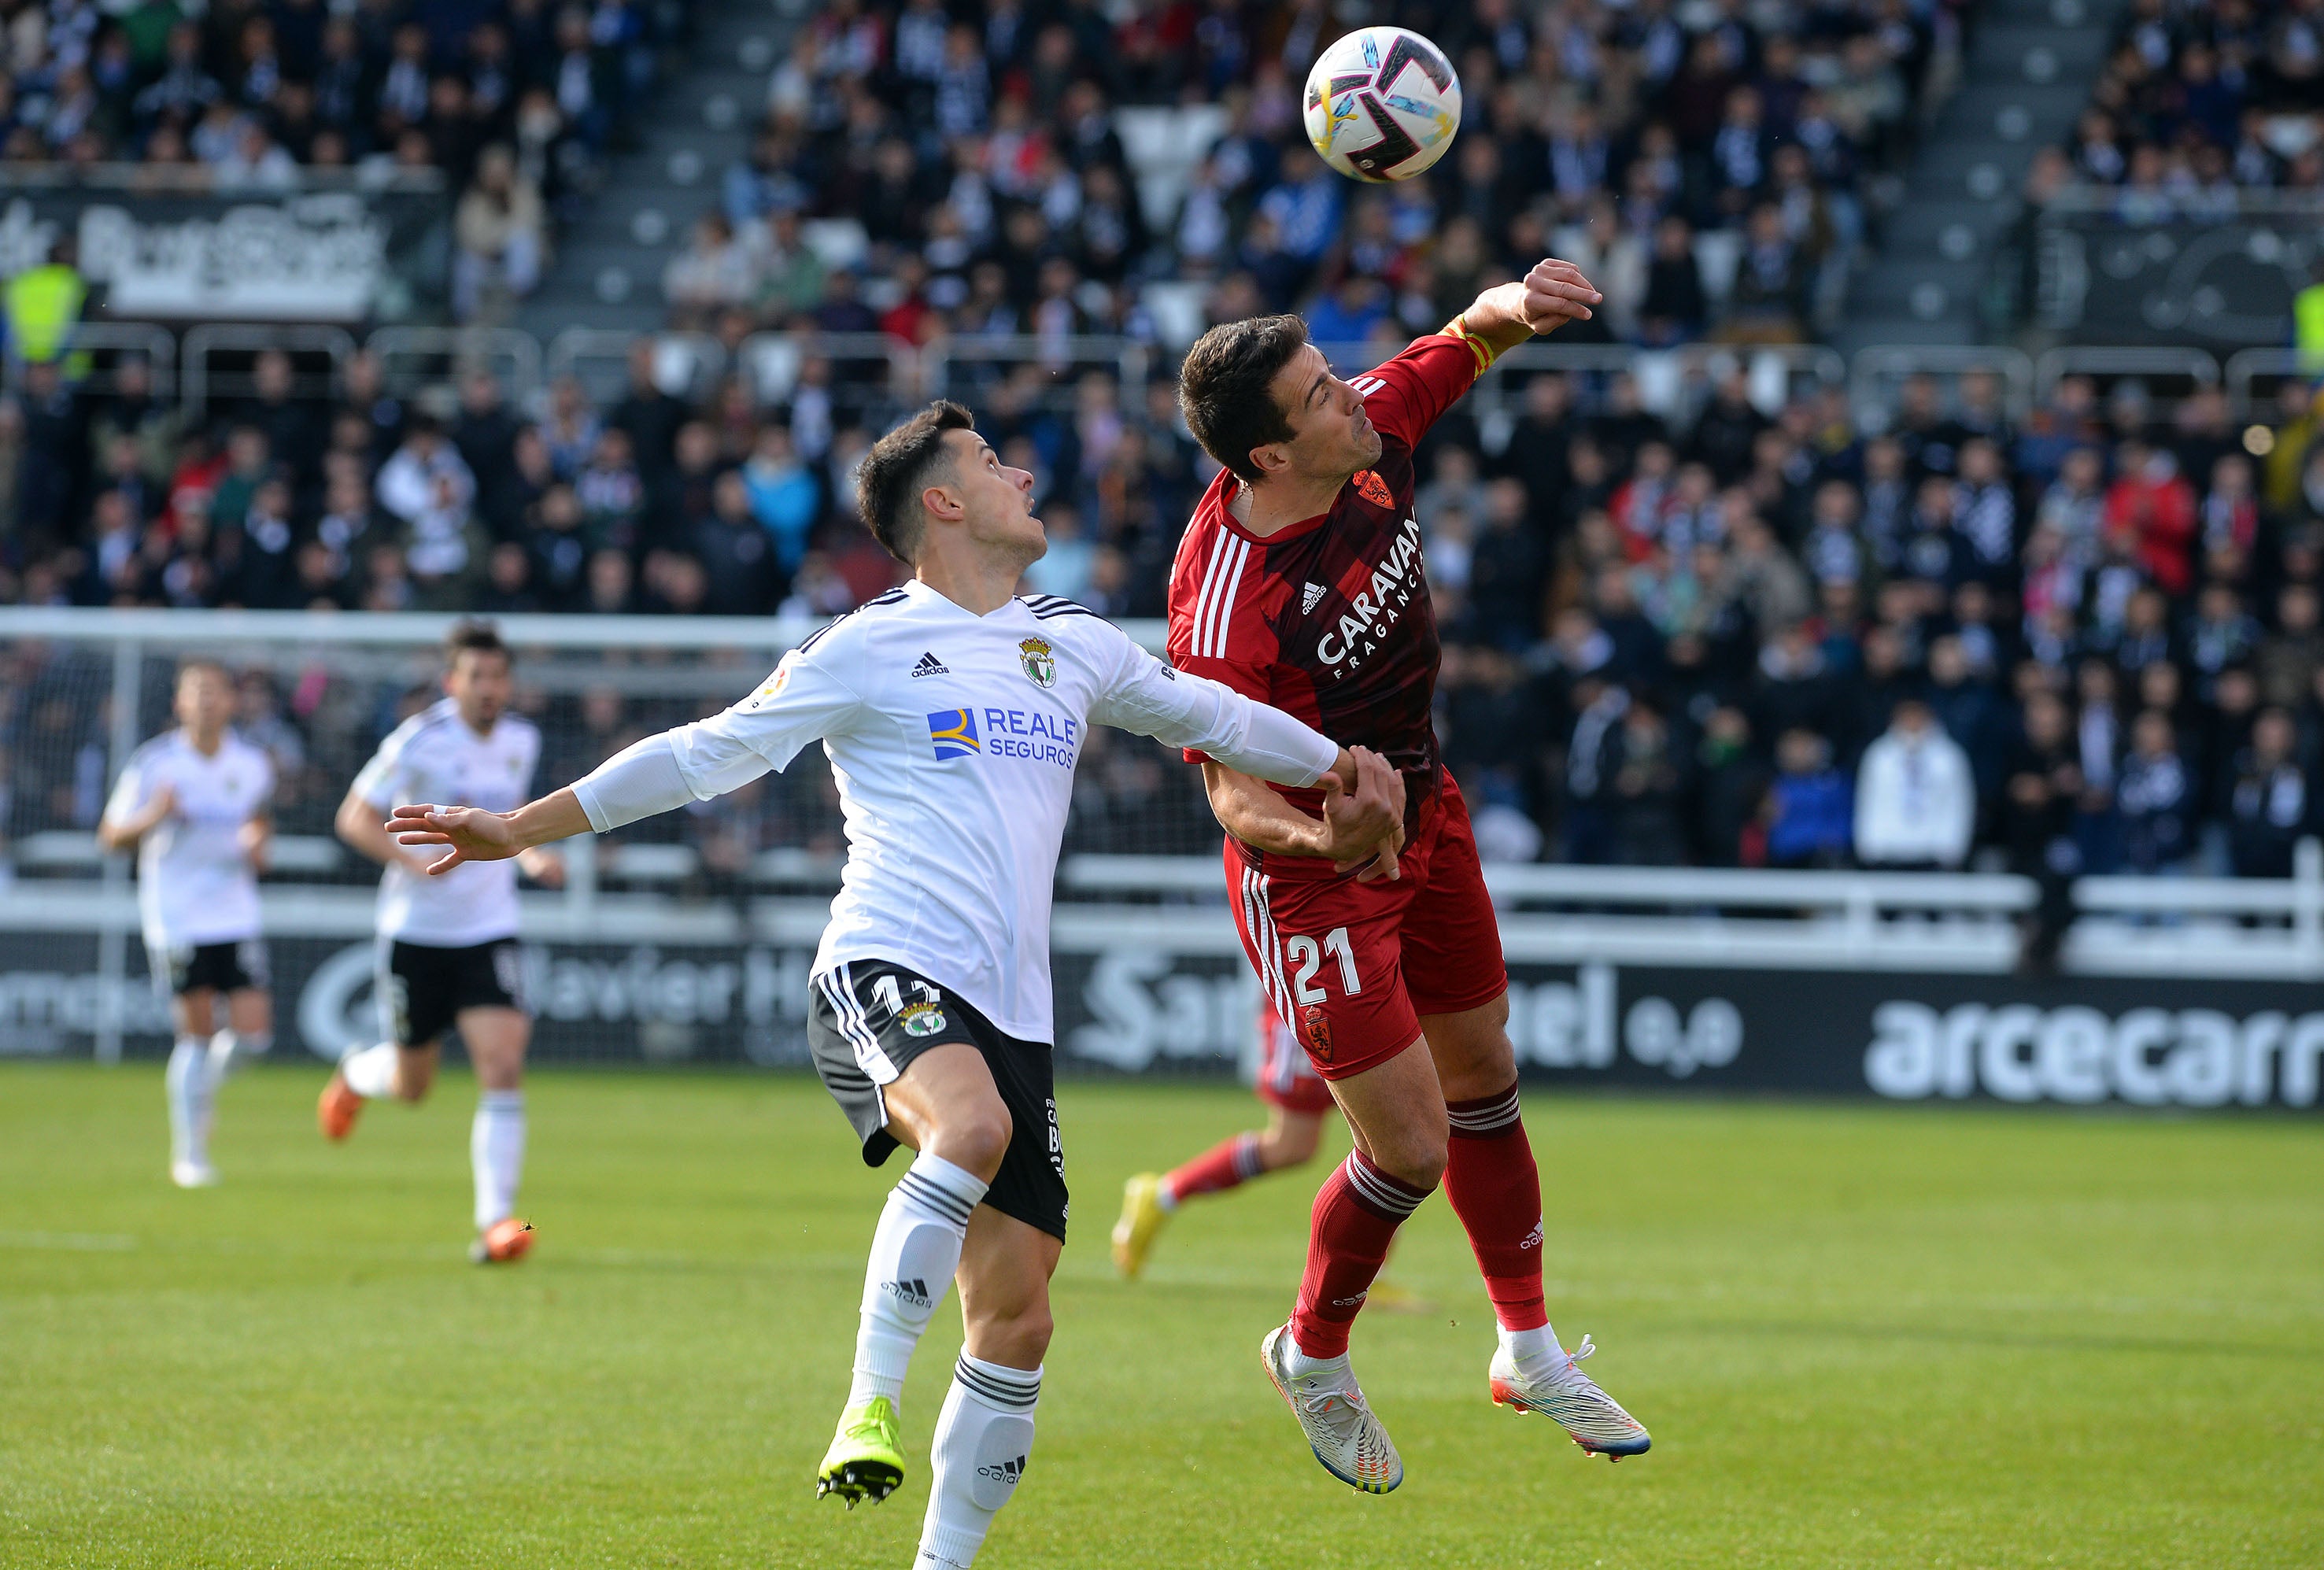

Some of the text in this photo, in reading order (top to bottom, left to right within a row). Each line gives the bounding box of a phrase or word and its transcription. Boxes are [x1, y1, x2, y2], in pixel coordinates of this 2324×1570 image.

[1302, 585, 1328, 615] adidas
[911, 666, 950, 678] adidas
[983, 707, 1077, 747] REALE
[988, 738, 1073, 770] SEGUROS
[1288, 926, 1362, 1007] 21
[881, 1281, 933, 1309] adidas
